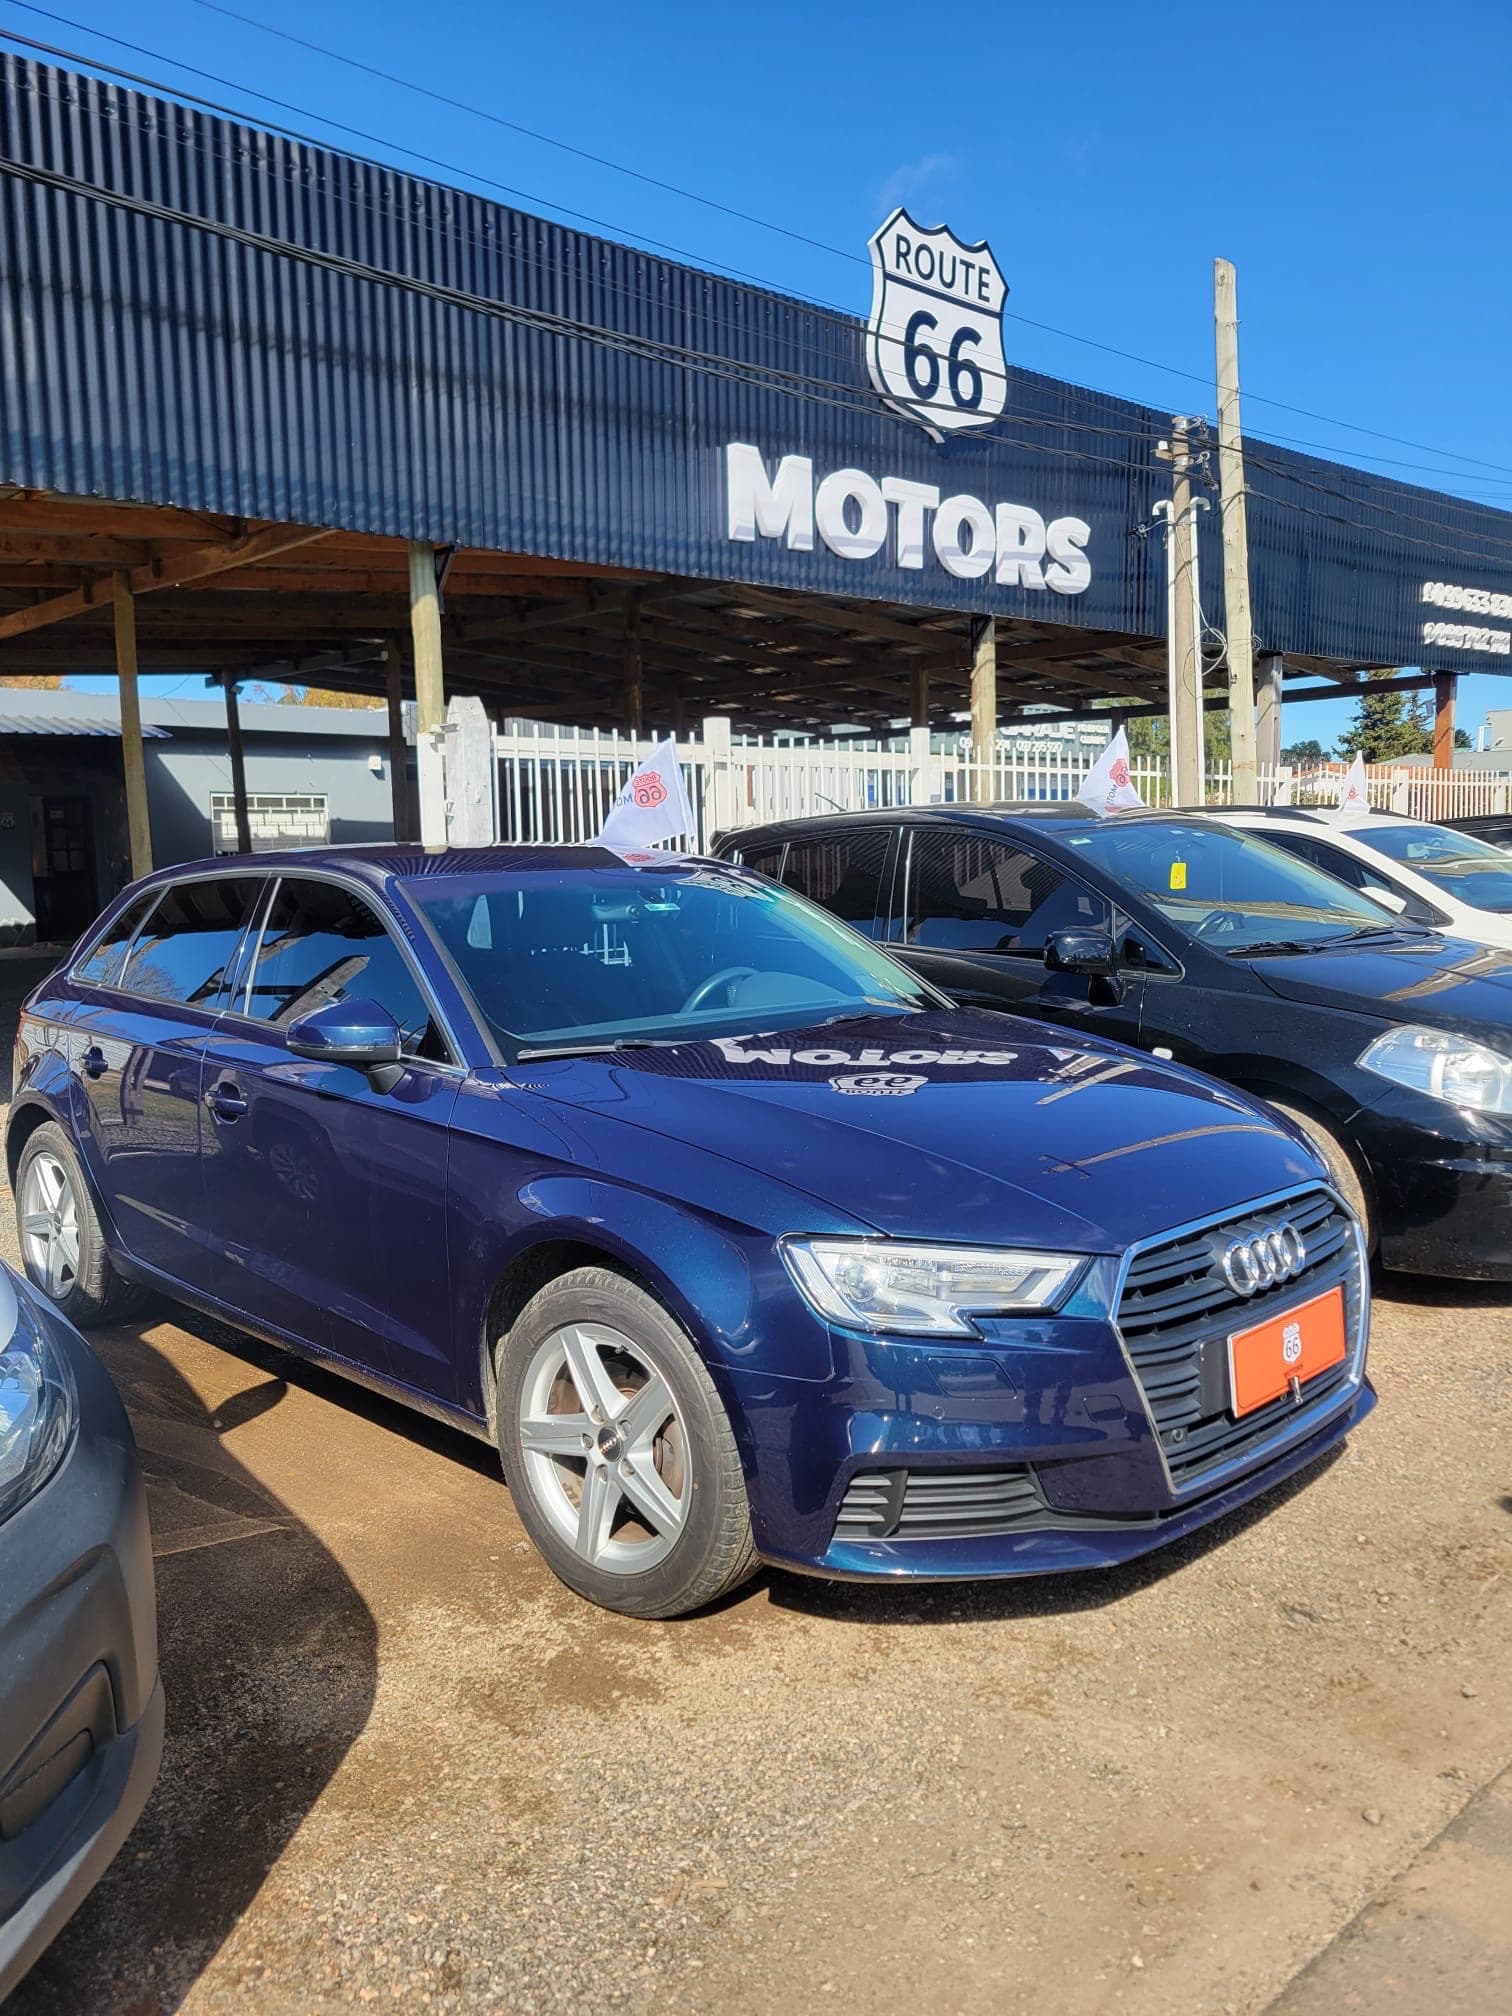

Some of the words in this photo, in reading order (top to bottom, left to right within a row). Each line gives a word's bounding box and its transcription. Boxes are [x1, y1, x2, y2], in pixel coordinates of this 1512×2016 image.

[895, 233, 990, 303] ROUTE
[904, 310, 982, 409] 66
[727, 442, 1092, 595] MOTORS
[1286, 1336, 1299, 1358] 66
